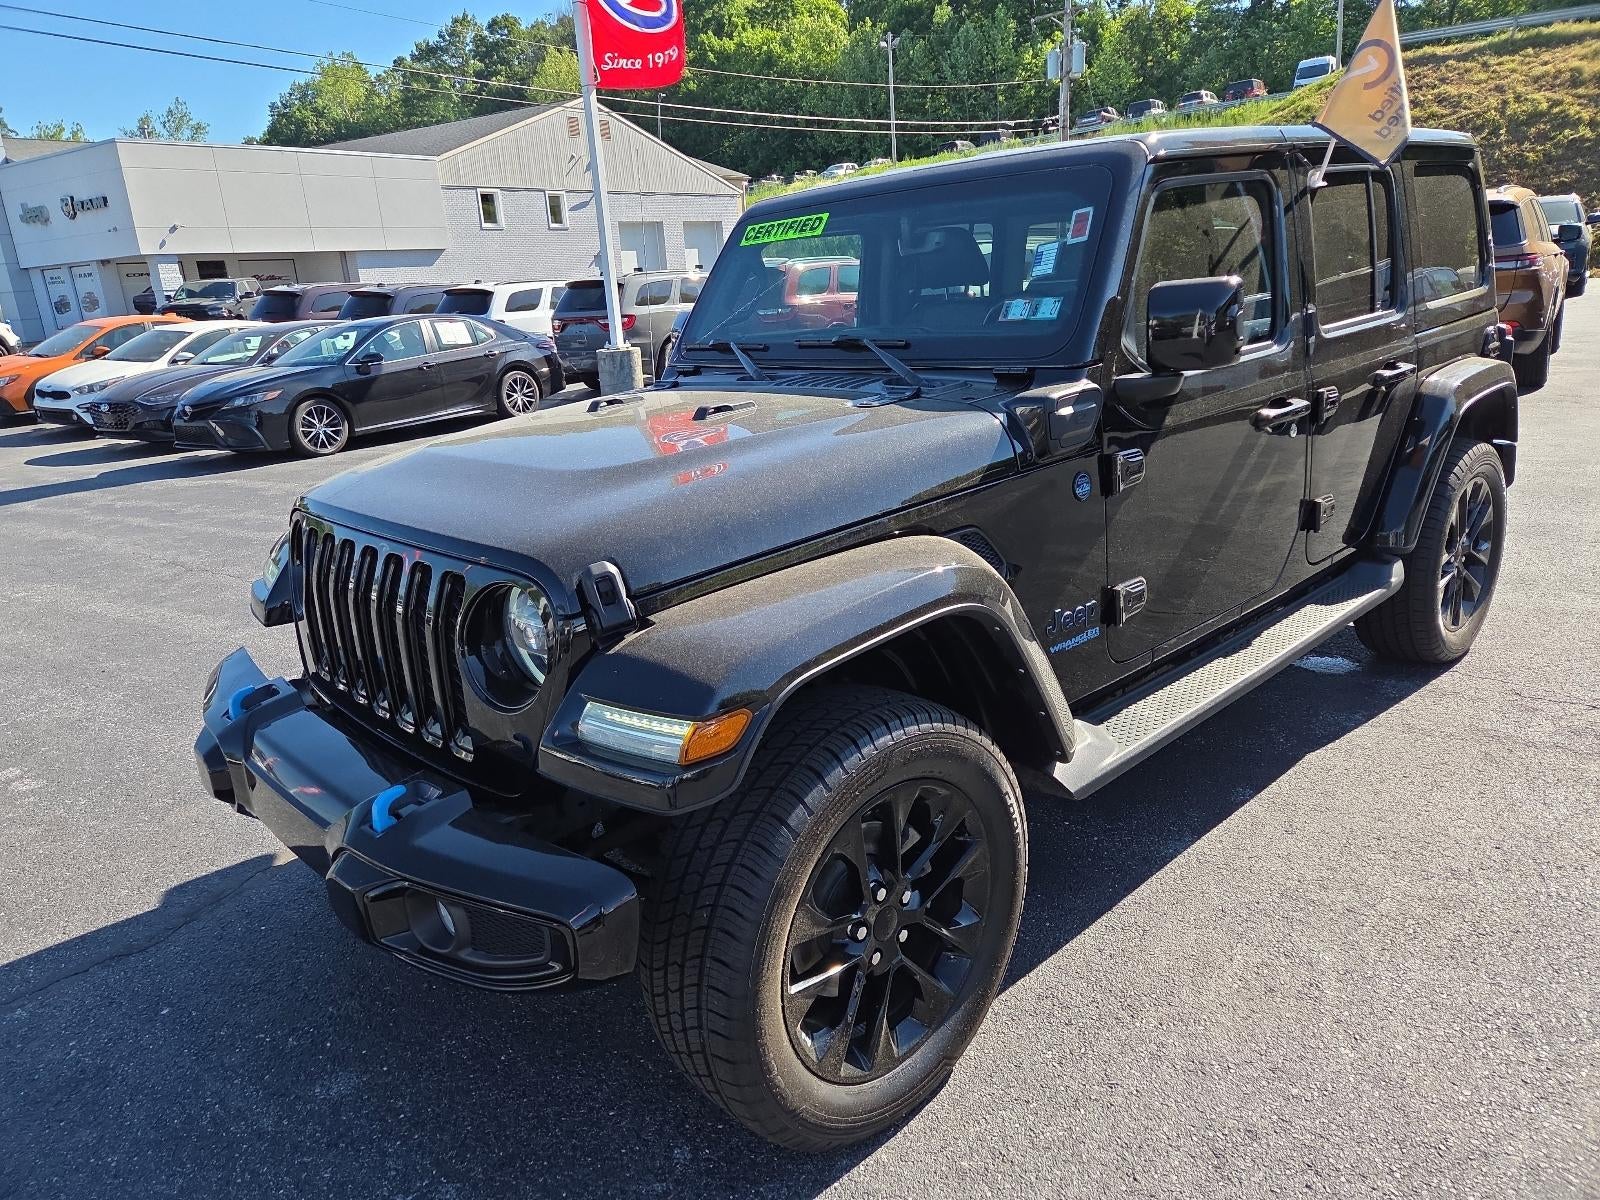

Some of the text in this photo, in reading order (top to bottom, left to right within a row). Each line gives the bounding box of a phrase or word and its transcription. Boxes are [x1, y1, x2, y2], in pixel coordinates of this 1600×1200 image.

[601, 45, 679, 70] Since 1979
[75, 196, 109, 212] RAM
[746, 217, 824, 240] CERTIFIED
[1046, 600, 1099, 638] Jeep
[1050, 627, 1100, 653] WRANGLER
